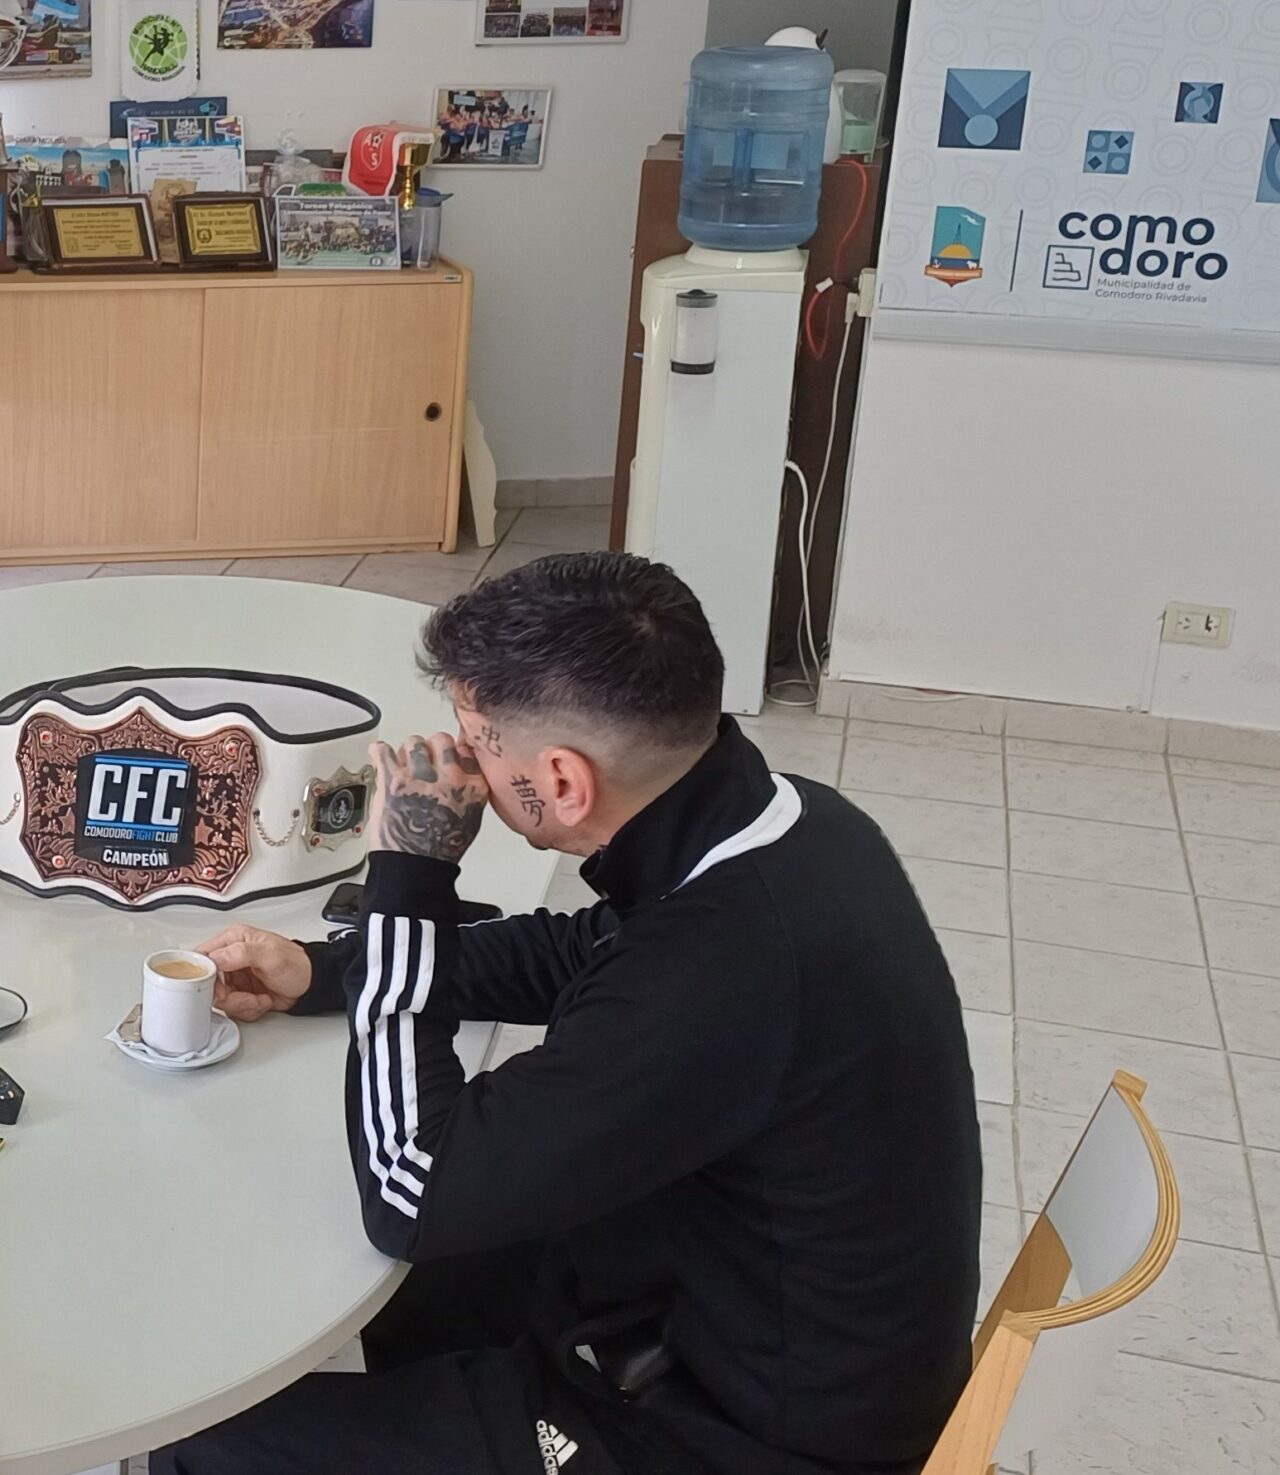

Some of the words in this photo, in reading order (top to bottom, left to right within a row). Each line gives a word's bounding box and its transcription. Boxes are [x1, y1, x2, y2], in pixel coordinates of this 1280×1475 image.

[1058, 211, 1215, 247] como
[1099, 247, 1228, 280] doro
[1095, 288, 1152, 301] Comodoro
[1155, 291, 1207, 303] Rivadavia
[1097, 278, 1174, 291] Municipalidad
[1177, 282, 1191, 291] de
[87, 764, 187, 826] CFC
[103, 848, 169, 866] CAMPEÓN
[536, 1420, 559, 1475] adidas
